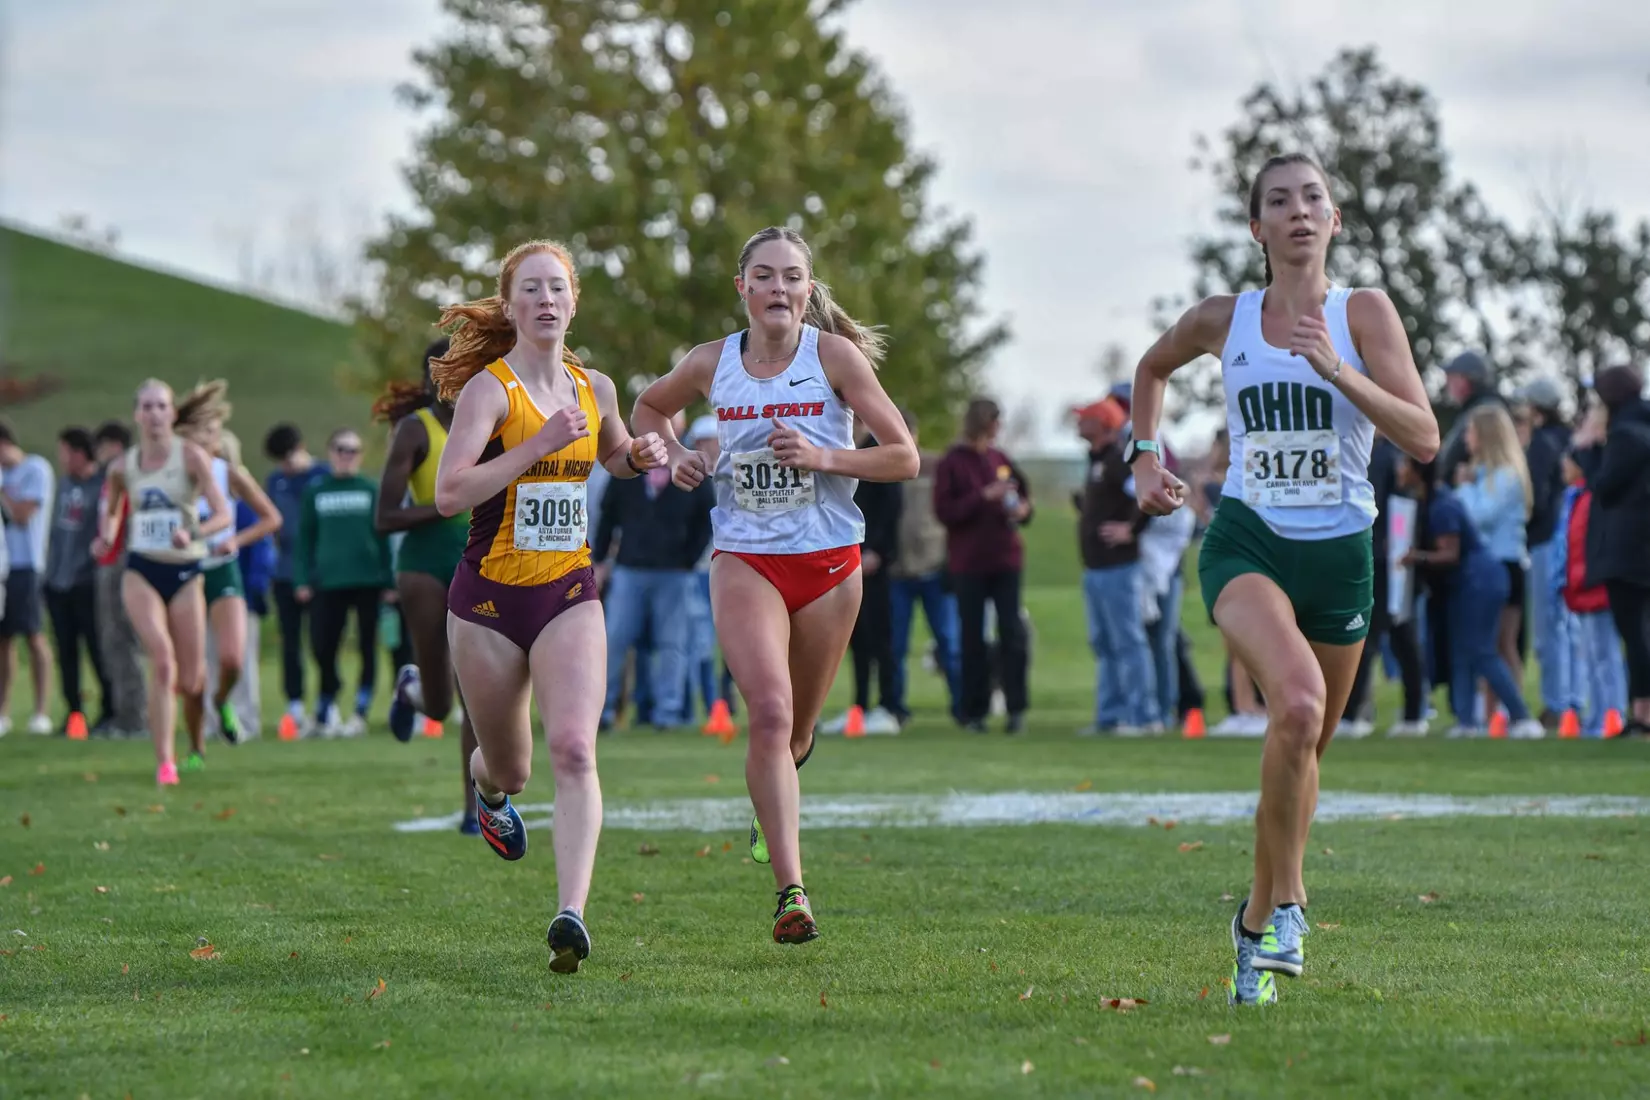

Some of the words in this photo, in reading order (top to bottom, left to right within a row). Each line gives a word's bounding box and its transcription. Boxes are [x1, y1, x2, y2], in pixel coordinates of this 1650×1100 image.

[762, 402, 825, 419] STATE
[1238, 382, 1333, 434] OHIO
[521, 460, 560, 477] ENTRAL
[1253, 449, 1329, 480] 3178
[740, 463, 804, 490] 3031
[772, 496, 789, 504] STATE
[524, 498, 583, 527] 3098
[472, 606, 500, 618] adidas
